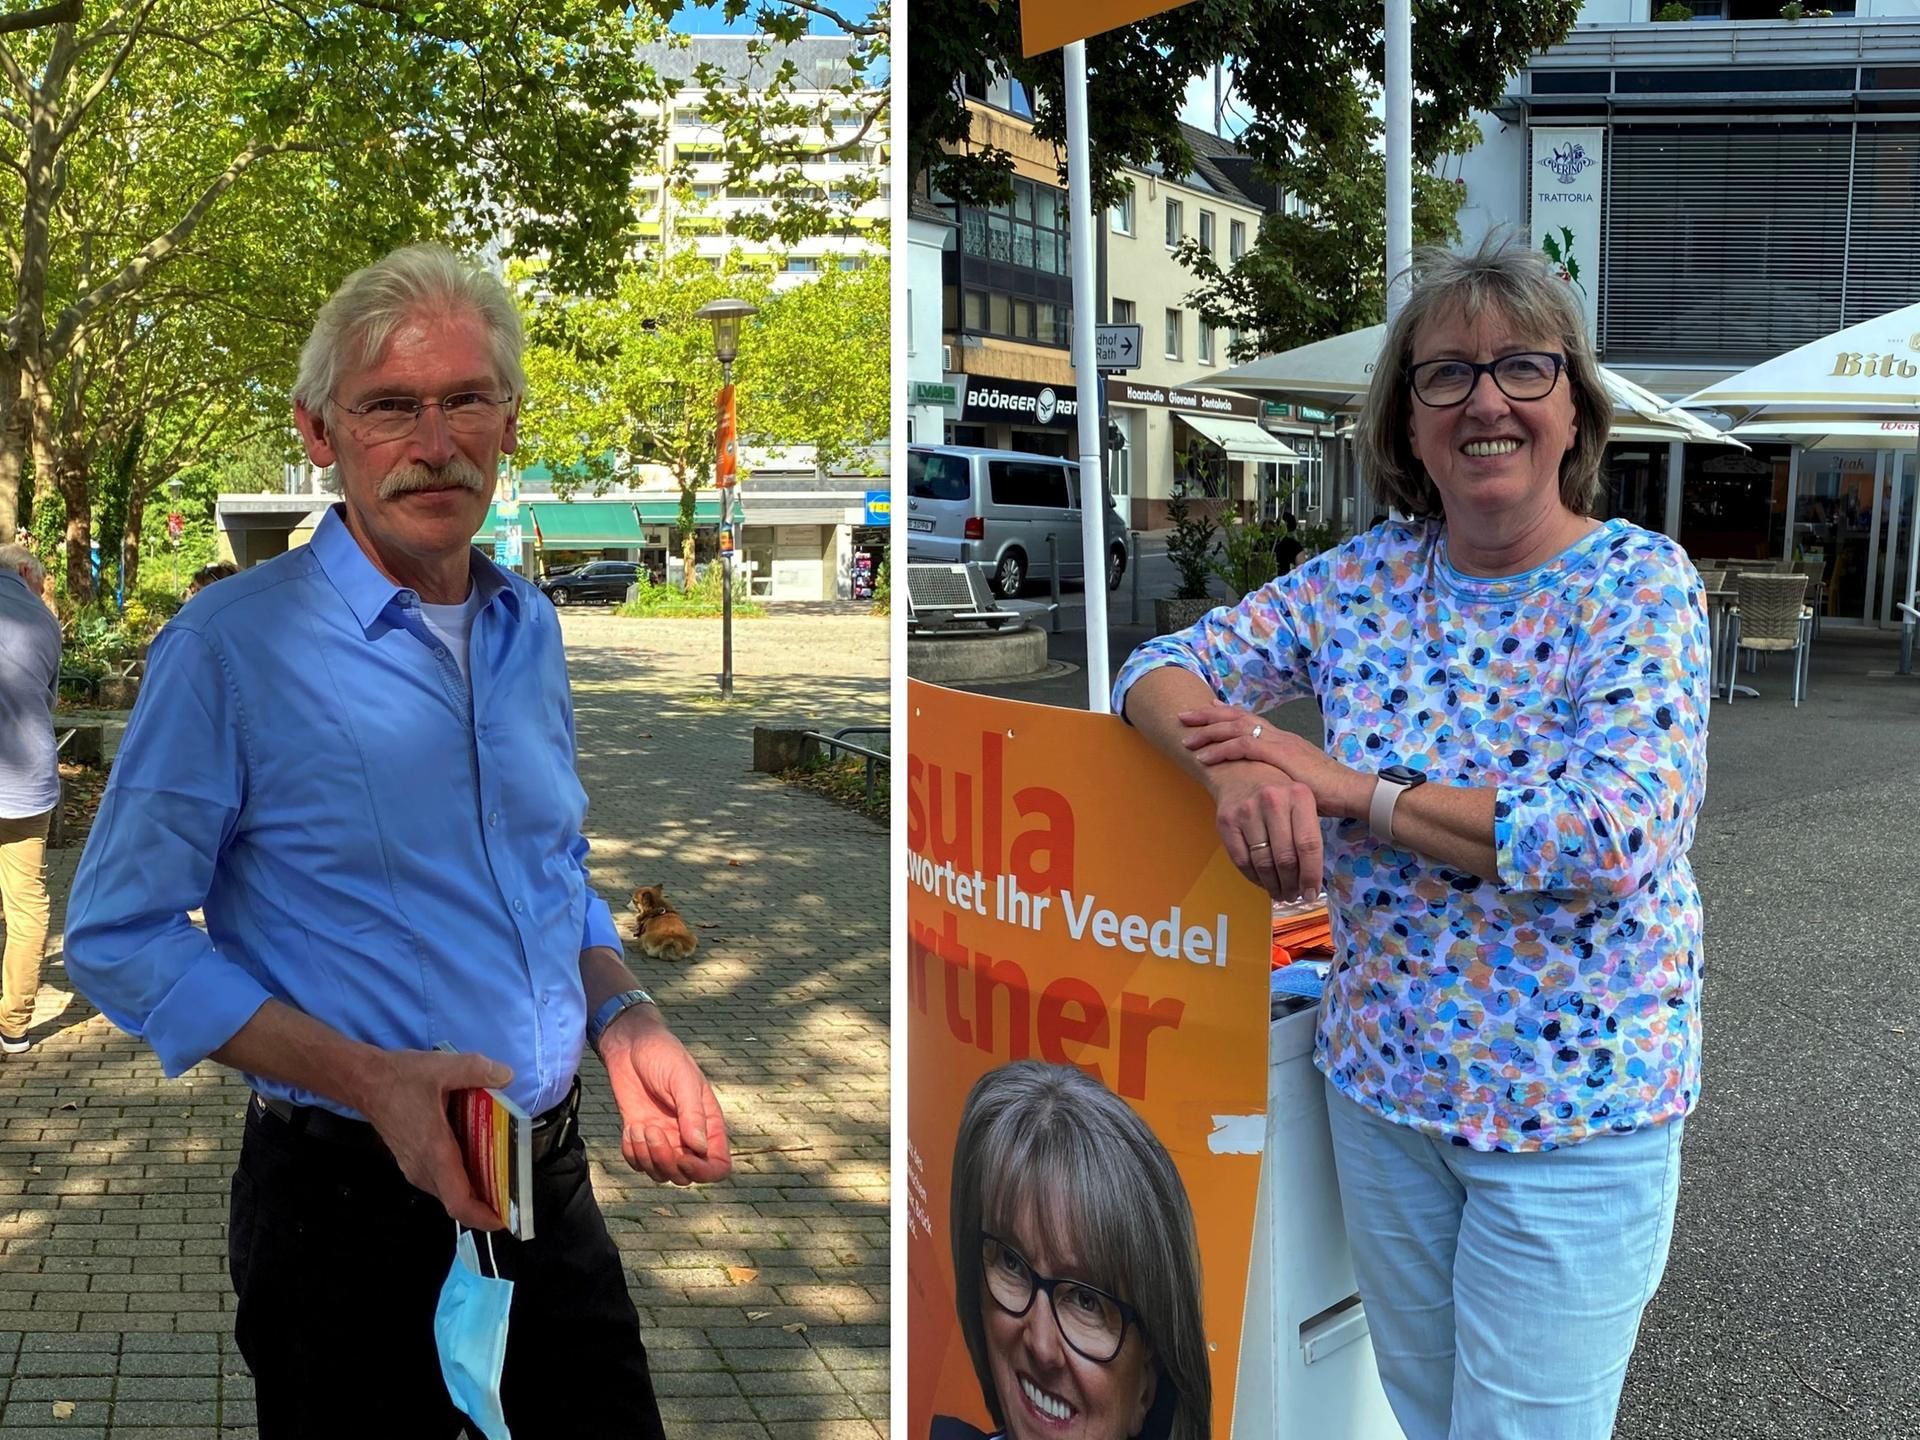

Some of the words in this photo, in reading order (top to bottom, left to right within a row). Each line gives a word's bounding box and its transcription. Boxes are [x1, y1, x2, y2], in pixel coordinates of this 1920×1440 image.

[1551, 160, 1583, 175] PERINO
[1538, 193, 1593, 202] TRATTORIA
[1097, 348, 1116, 360] Rath
[967, 388, 1036, 411] BÖÖRGER
[1127, 386, 1164, 403] Haarstudio
[1168, 392, 1197, 406] Giovanni
[1201, 396, 1232, 411] Santalucia
[907, 848, 987, 915] wortet
[996, 874, 1051, 931] Ihr
[1060, 889, 1228, 967] Veedel
[908, 911, 1185, 1101] rtner
